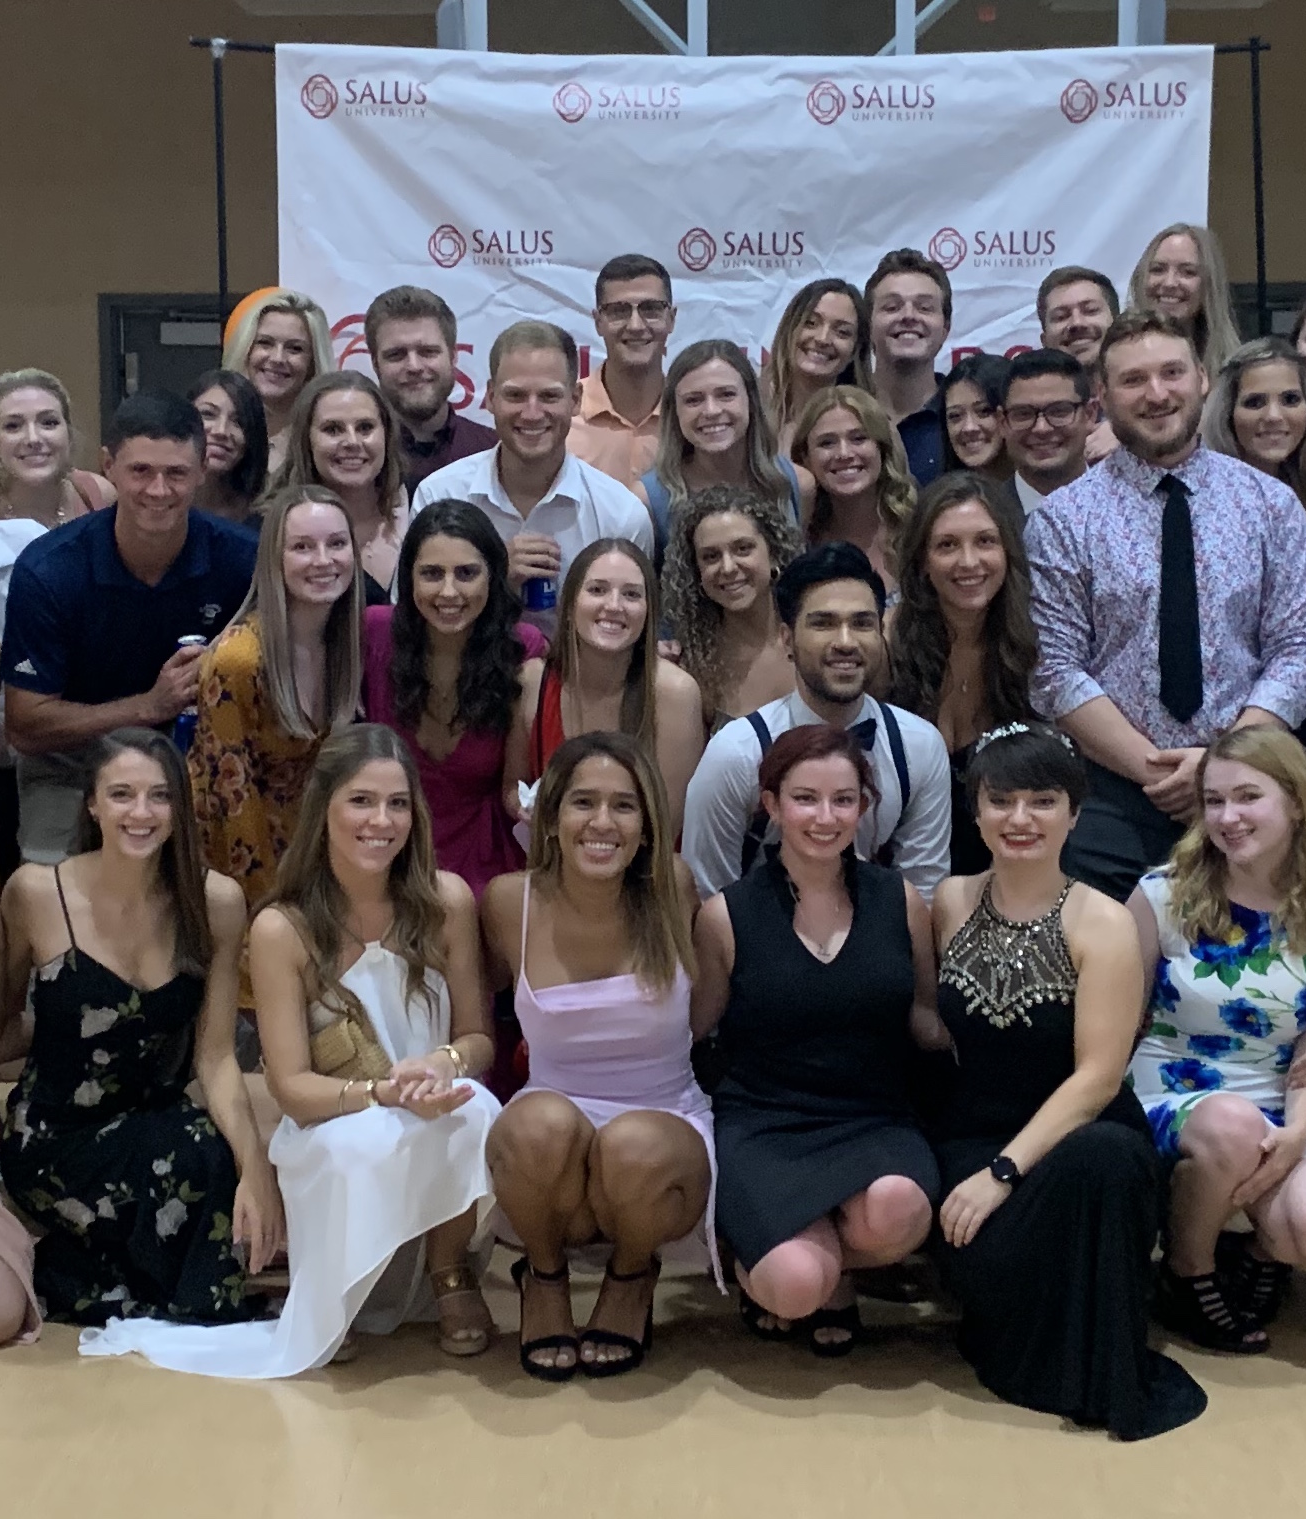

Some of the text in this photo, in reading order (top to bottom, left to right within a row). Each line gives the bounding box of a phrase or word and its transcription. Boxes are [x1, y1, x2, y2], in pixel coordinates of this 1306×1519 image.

[345, 79, 427, 105] SALUS
[598, 86, 681, 108] SALUS
[852, 84, 935, 109] SALUS
[1103, 82, 1187, 108] SALUS
[345, 107, 427, 118] UNIVERSITY
[598, 110, 681, 121] UNIVERSITY
[852, 112, 934, 122] UNIVERSITY
[1103, 109, 1185, 120] UNIVERSITY
[472, 229, 553, 255] SALUS
[723, 231, 805, 256] SALUS
[973, 230, 1056, 255] SALUS
[472, 256, 552, 267] UNIVERSITY
[723, 258, 803, 269] UNIVERSITY
[973, 257, 1054, 268] UNIVERSITY
